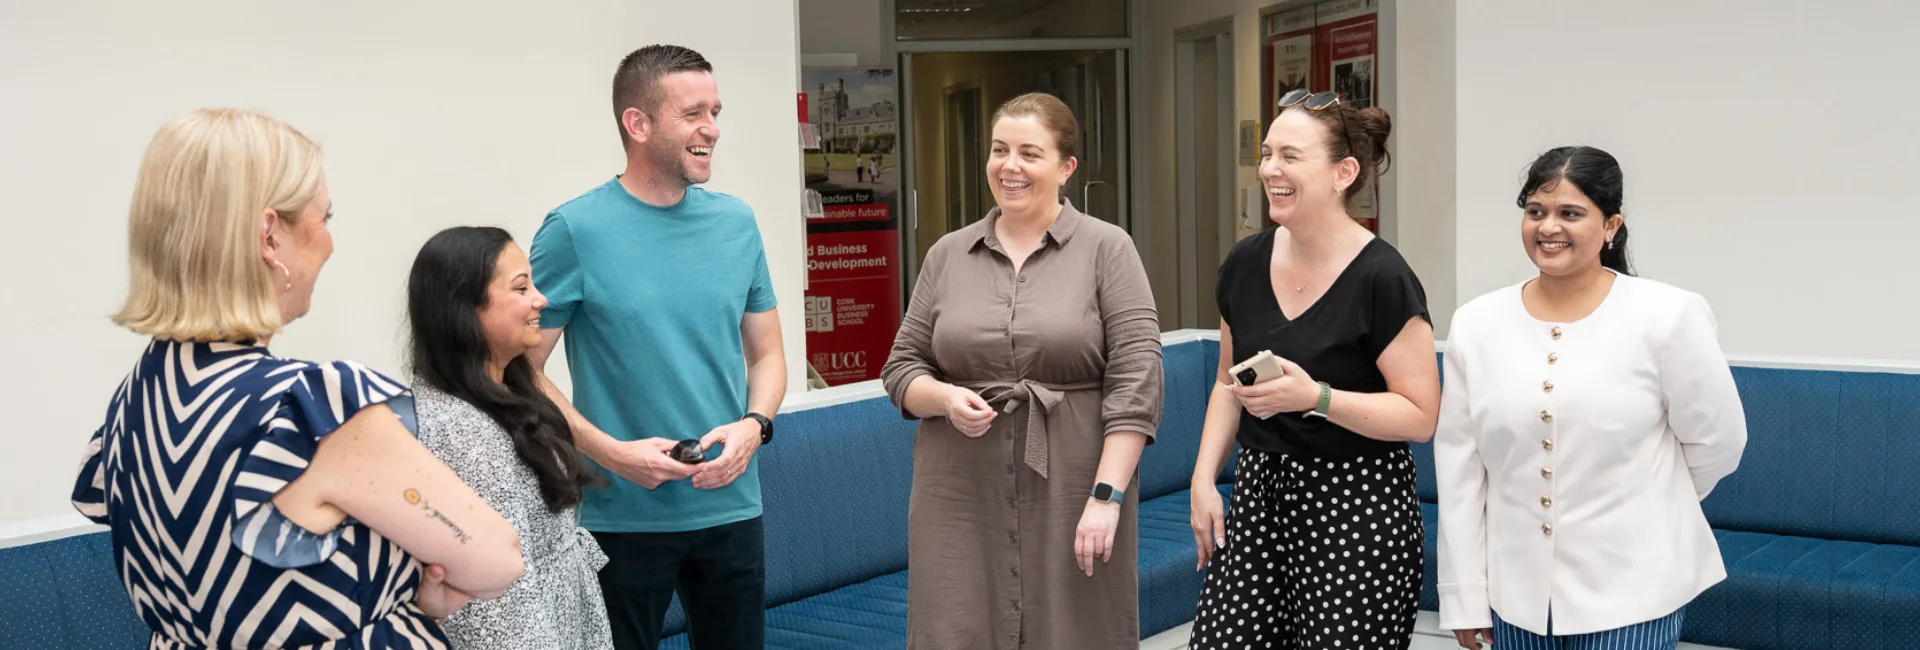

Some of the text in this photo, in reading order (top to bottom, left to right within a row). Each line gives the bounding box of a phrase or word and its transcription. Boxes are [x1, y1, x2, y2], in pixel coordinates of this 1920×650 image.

[823, 193, 869, 204] eaders for
[824, 207, 886, 218] ainable future
[817, 244, 867, 256] Business
[837, 303, 875, 313] UNIVERSITY
[837, 310, 868, 320] BUSINESS
[838, 318, 864, 326] SCHOOL
[831, 350, 866, 370] UCC
